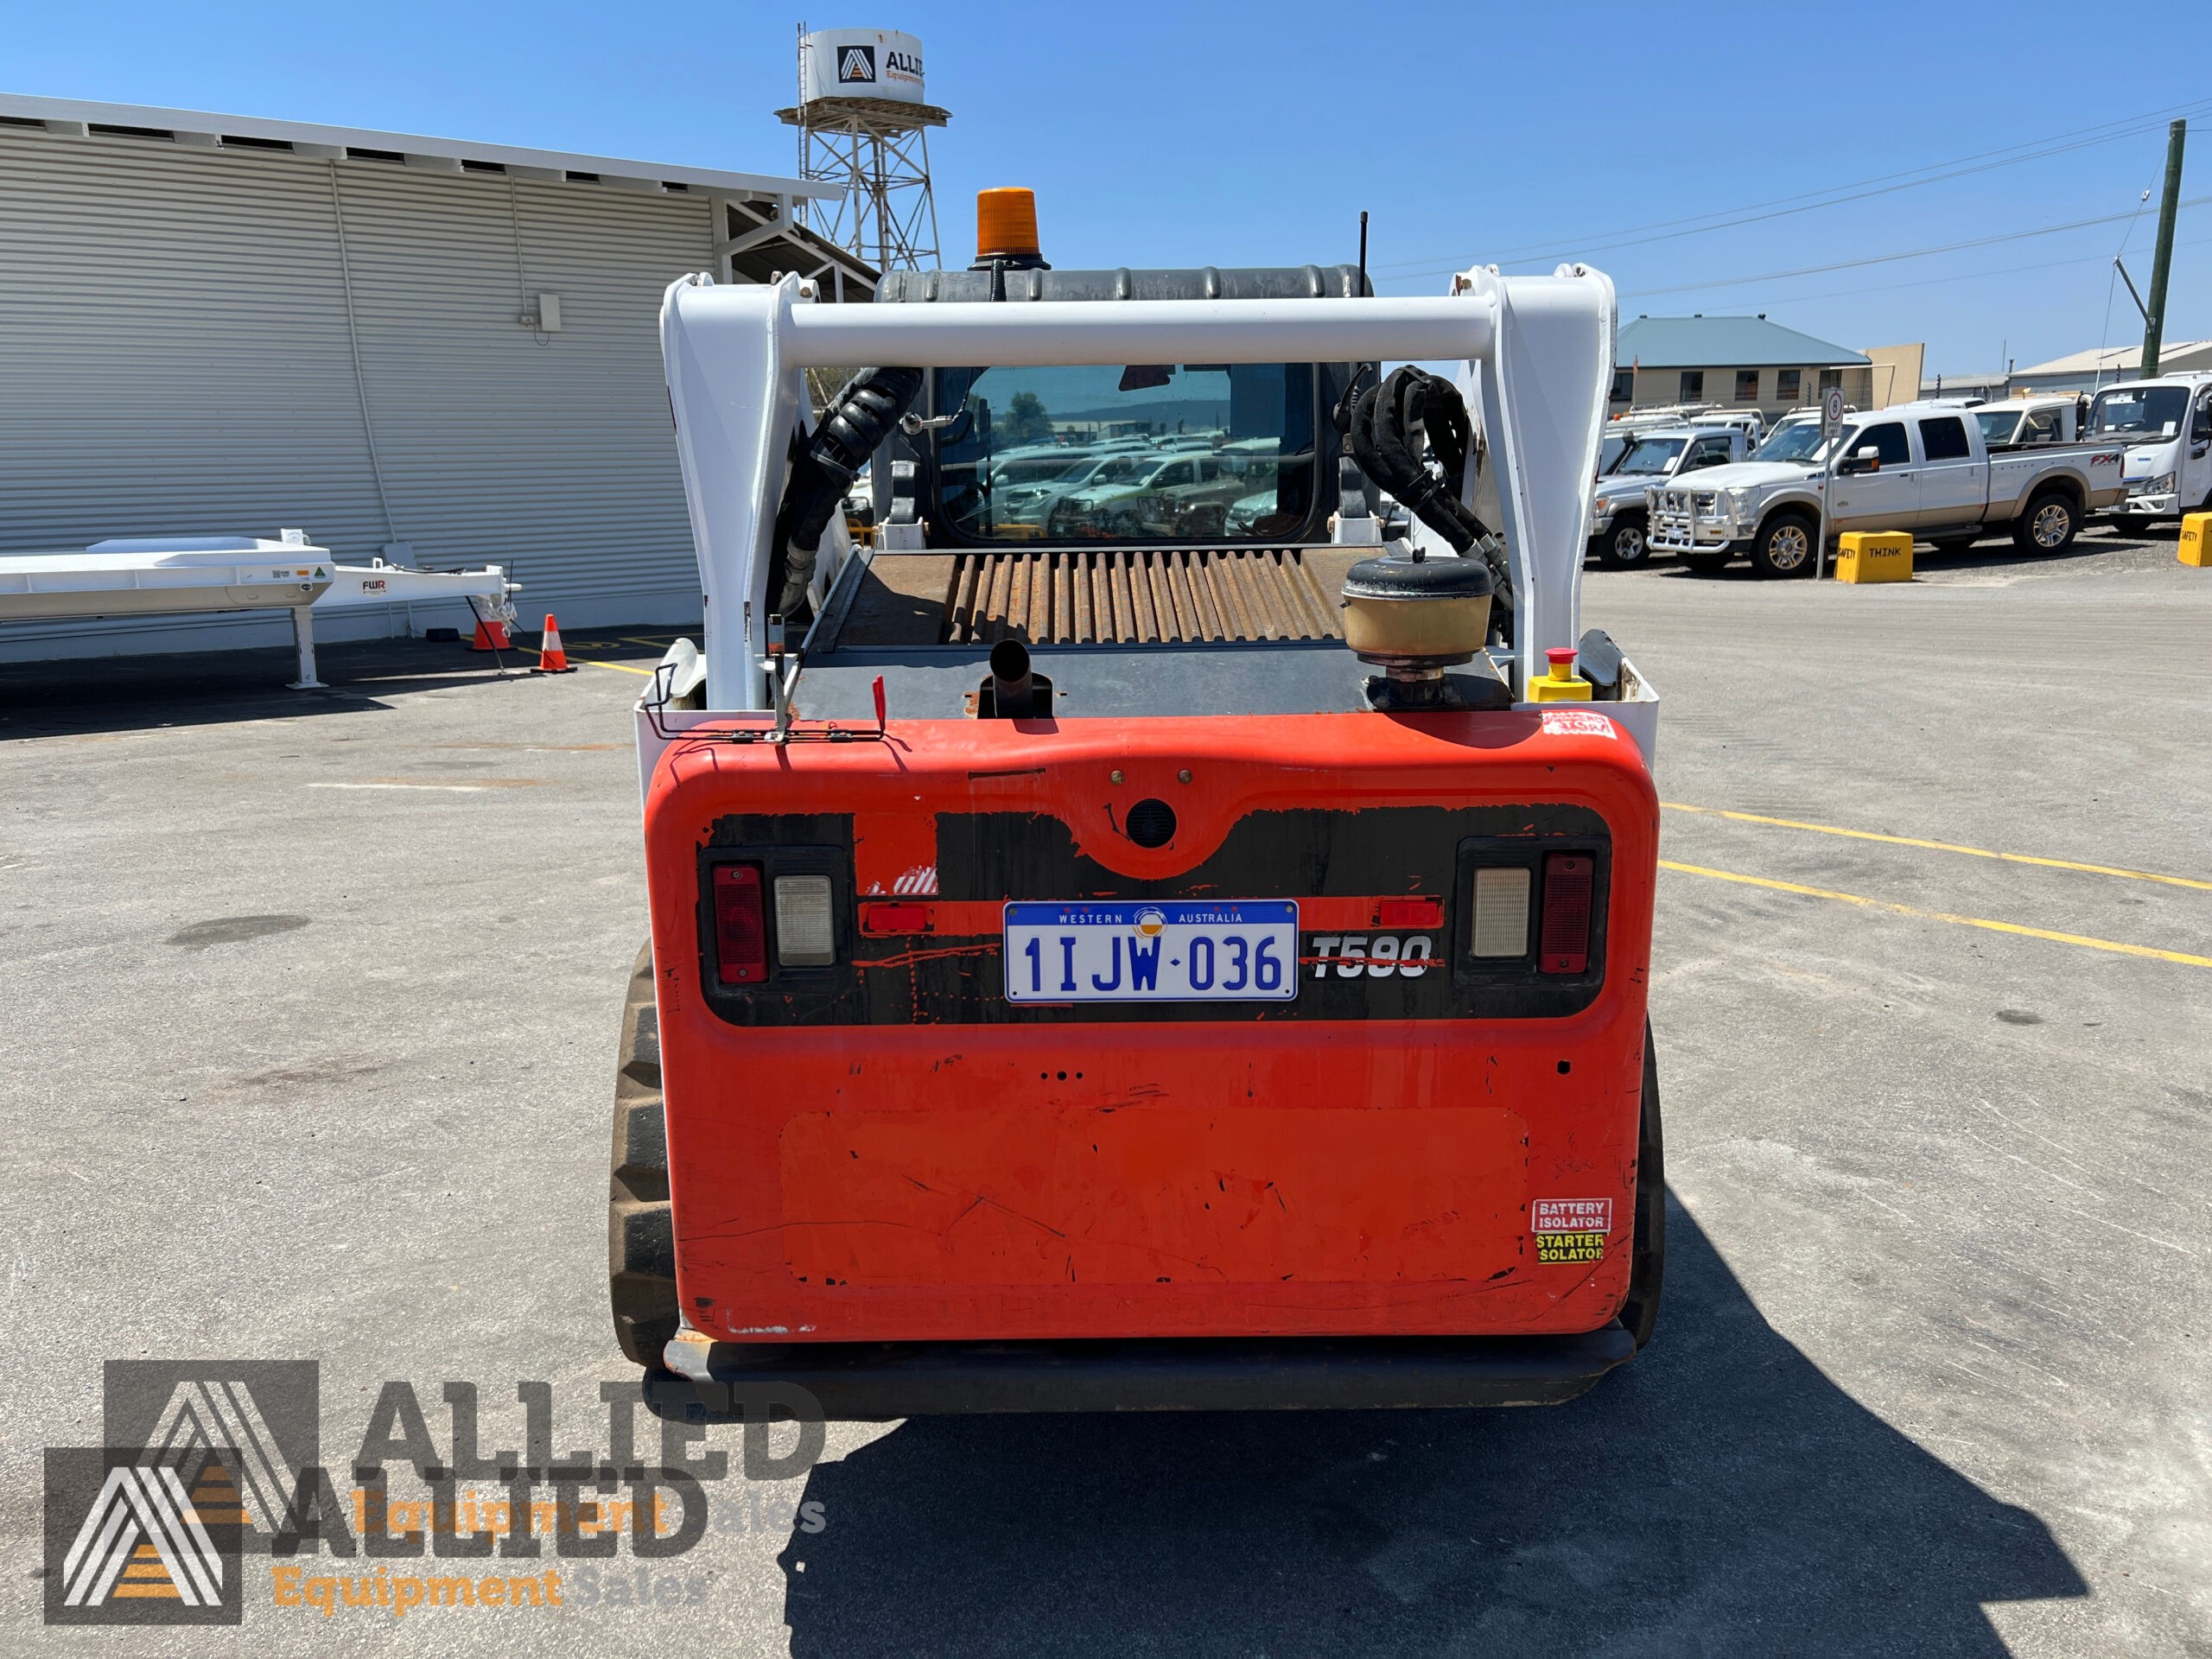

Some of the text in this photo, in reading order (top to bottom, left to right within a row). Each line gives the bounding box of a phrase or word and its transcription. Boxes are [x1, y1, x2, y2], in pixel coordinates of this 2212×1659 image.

[1832, 399, 1838, 414] 8
[2091, 454, 2120, 467] FX4
[1869, 546, 1901, 558] THINK
[362, 580, 386, 590] FWR
[1058, 913, 1243, 924] WESTERN AUSTRALIA
[1313, 936, 1432, 978] T590
[1539, 1202, 1605, 1215] BATTERY
[1539, 1217, 1604, 1228] ISOLATOR
[1535, 1235, 1604, 1248] STARTER
